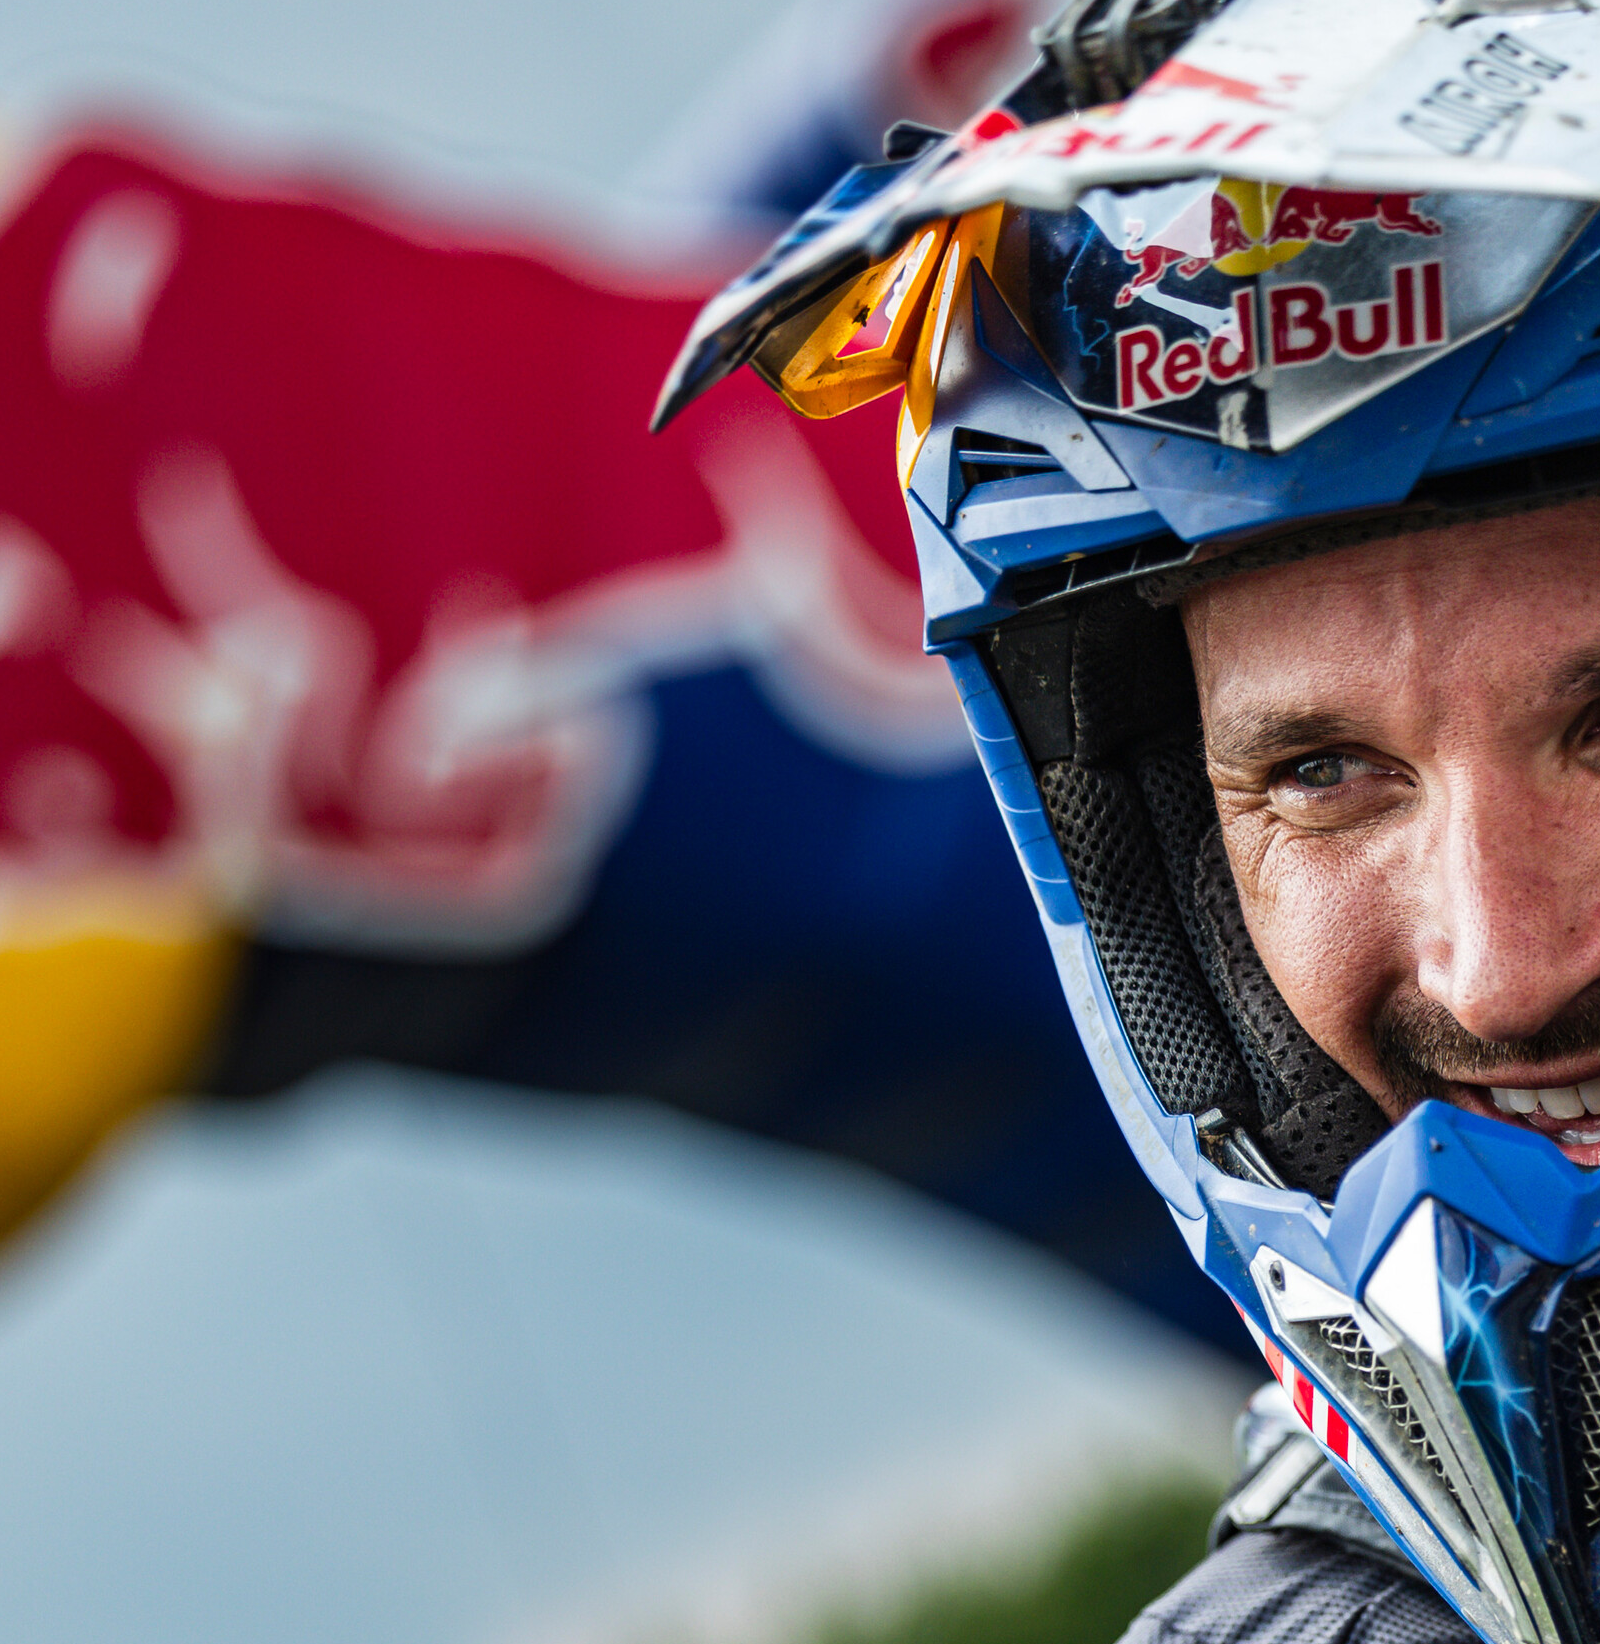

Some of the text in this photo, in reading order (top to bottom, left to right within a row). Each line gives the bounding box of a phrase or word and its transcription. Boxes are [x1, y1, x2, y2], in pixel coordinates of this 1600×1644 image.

[1398, 31, 1571, 158] AIROH
[1117, 260, 1447, 412] Red Bull
